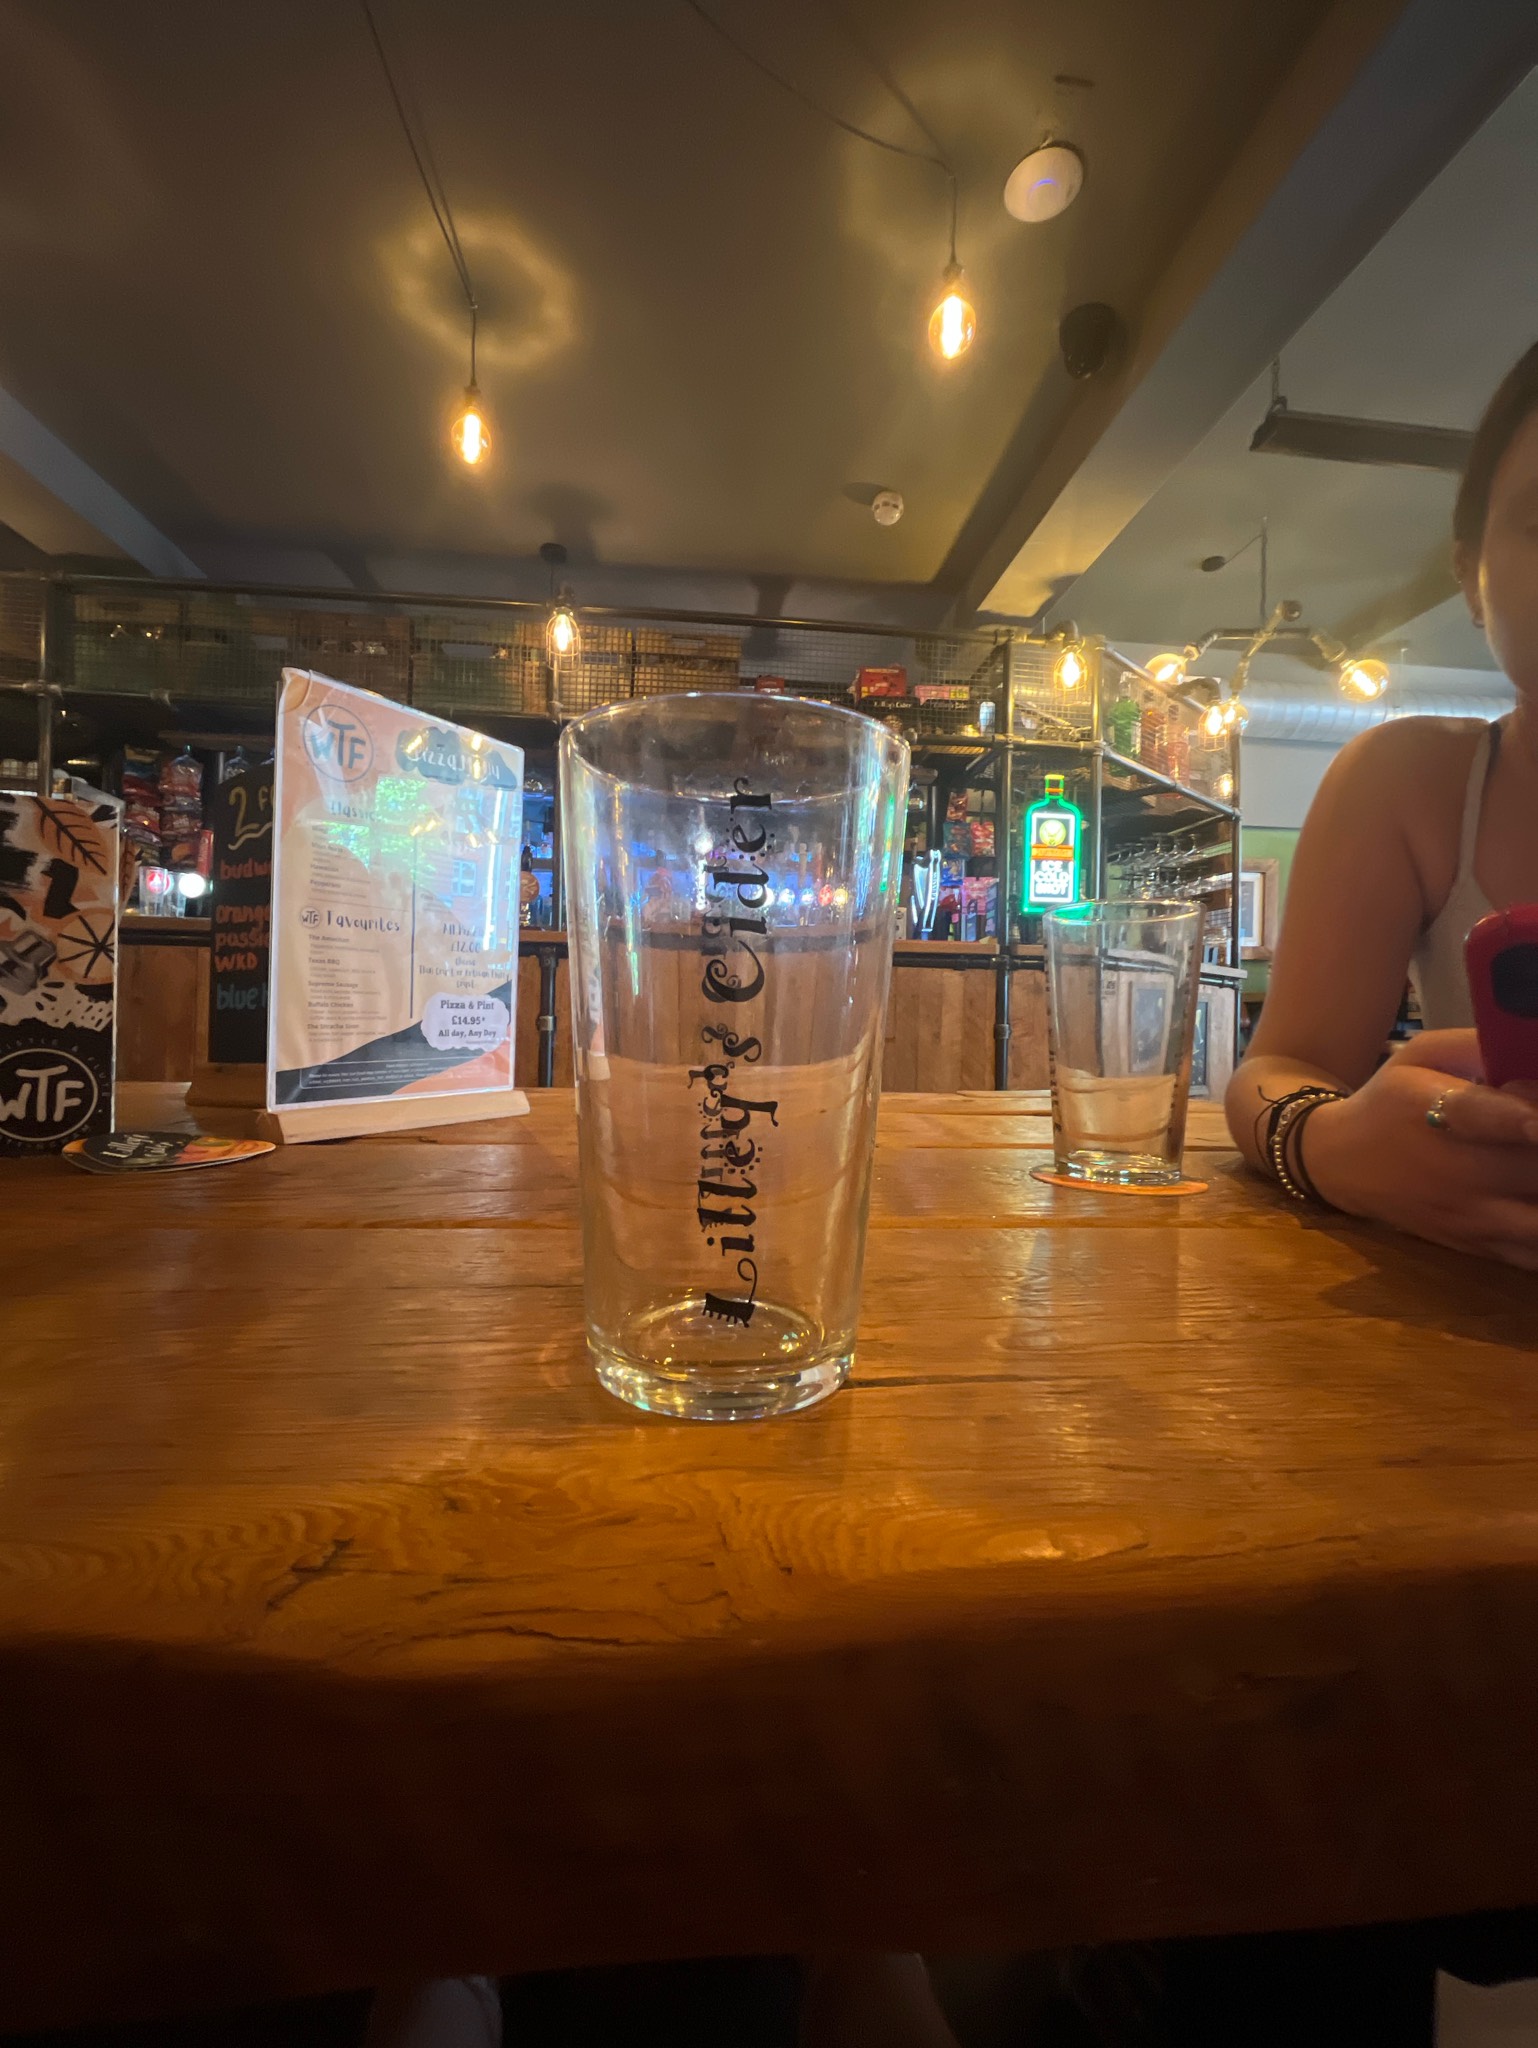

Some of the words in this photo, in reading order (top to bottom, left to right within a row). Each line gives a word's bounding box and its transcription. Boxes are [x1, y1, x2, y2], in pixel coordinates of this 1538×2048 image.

[310, 719, 366, 769] WTF
[229, 785, 250, 838] 2
[1034, 871, 1070, 884] COLD
[705, 777, 776, 1003] Cider
[215, 952, 259, 973] WKD
[440, 1000, 466, 1010] Pizza
[468, 1001, 475, 1010] &
[476, 1000, 495, 1010] Pint
[438, 1029, 450, 1038] All
[467, 1029, 483, 1039] Any
